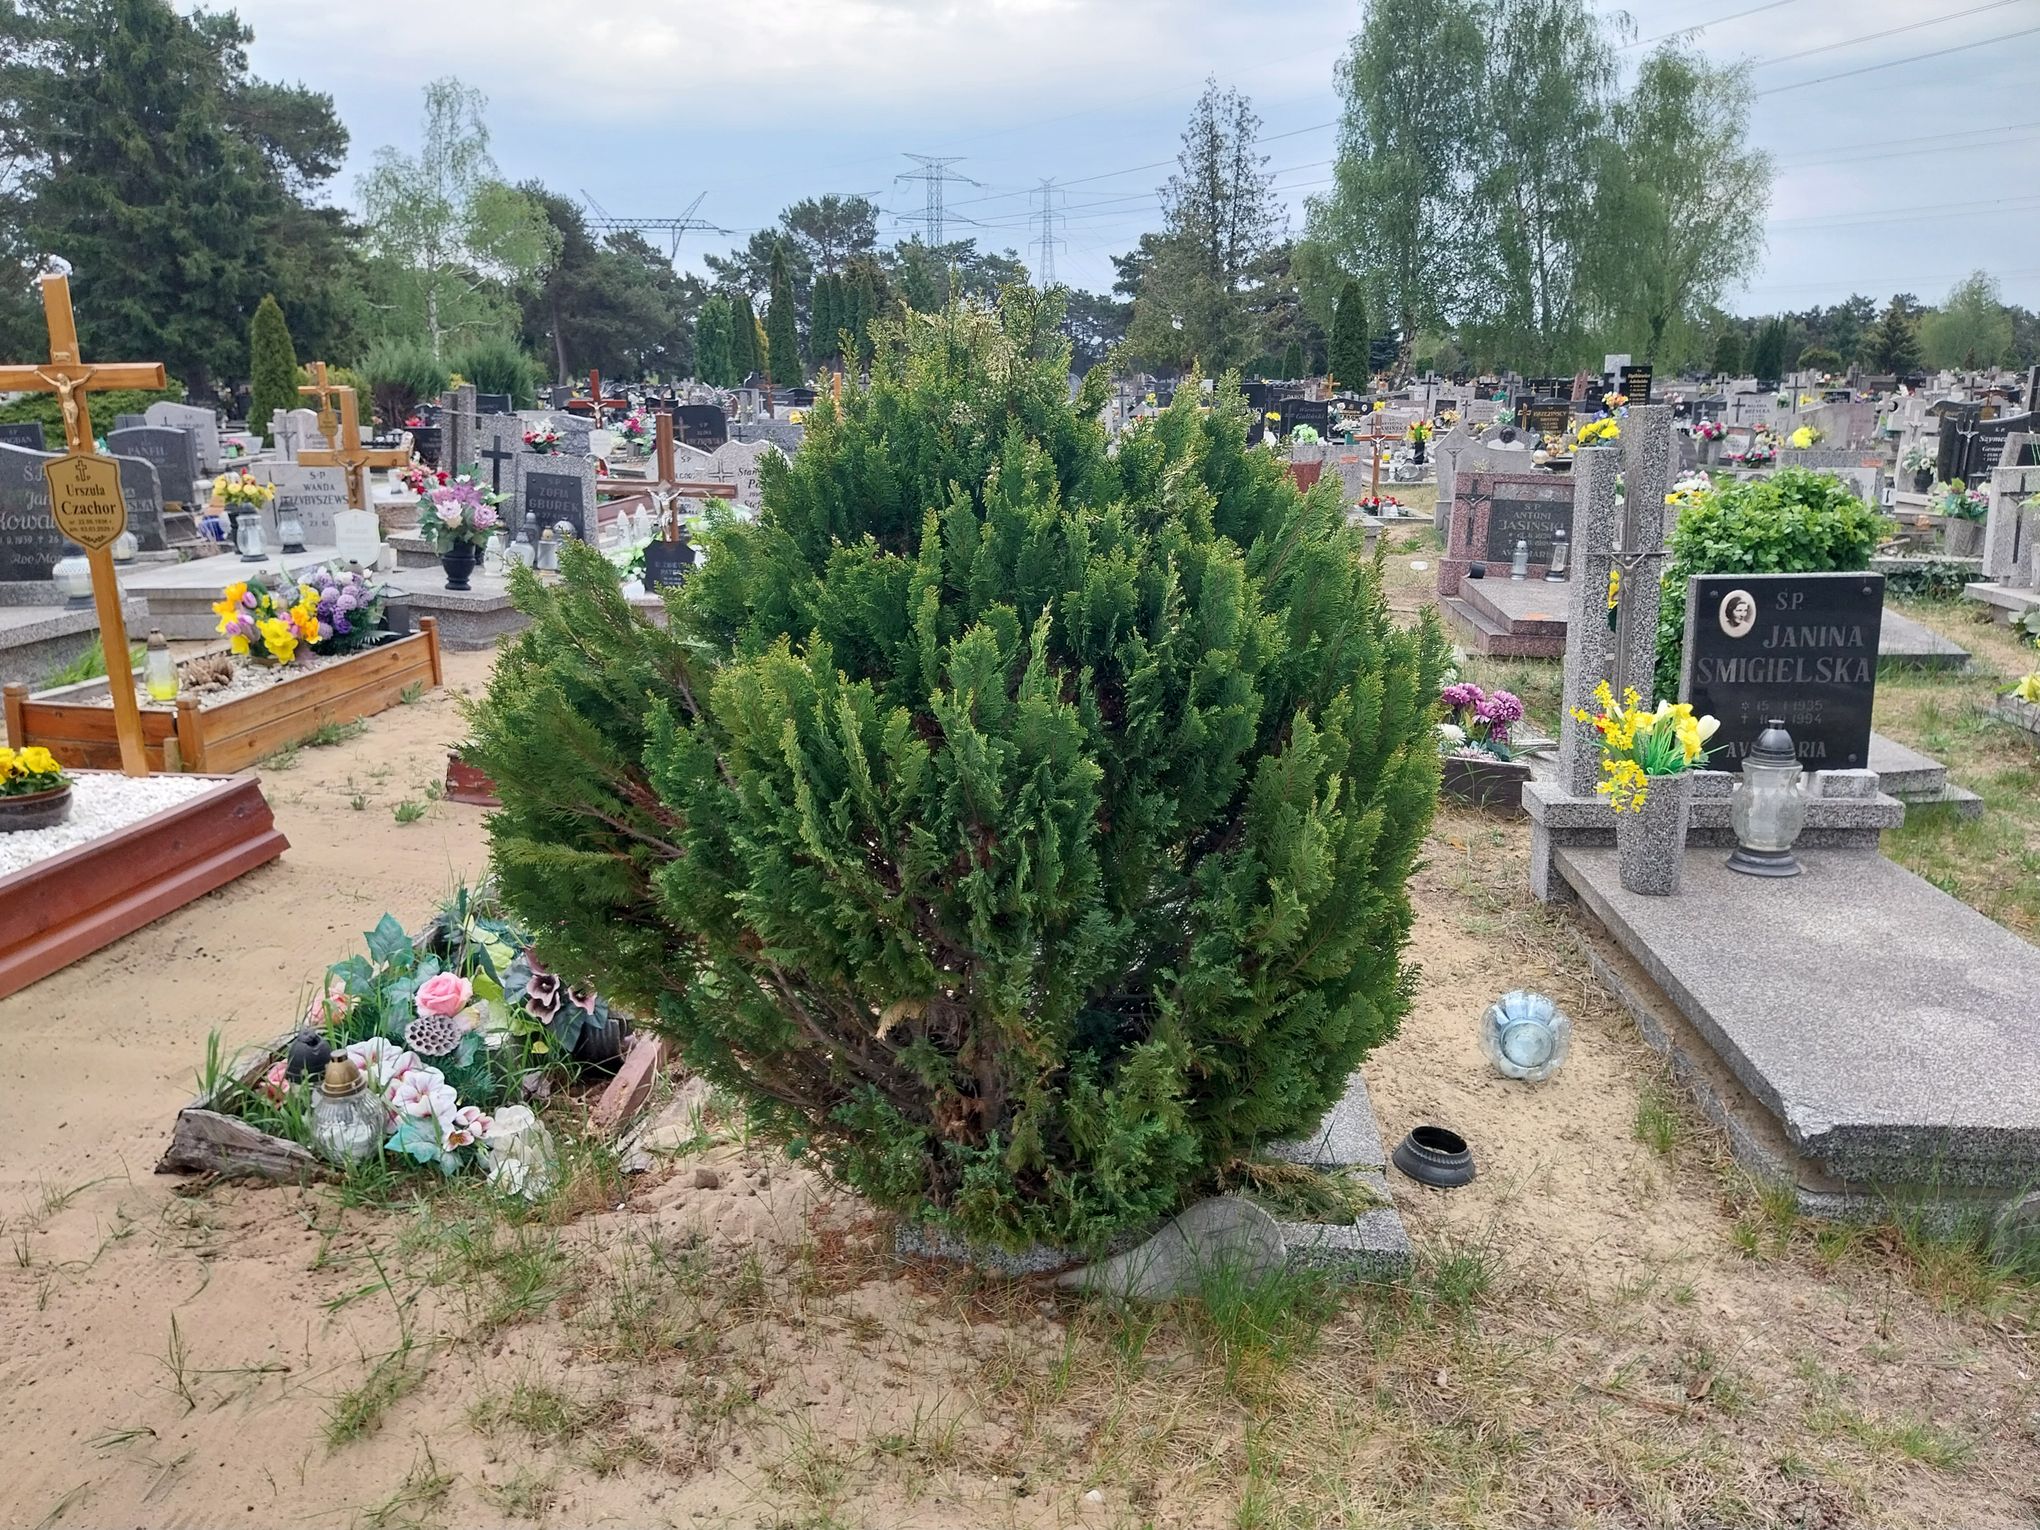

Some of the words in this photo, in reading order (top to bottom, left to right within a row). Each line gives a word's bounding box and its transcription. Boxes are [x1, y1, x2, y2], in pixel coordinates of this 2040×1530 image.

[65, 484, 106, 497] Urszula
[303, 483, 336, 492] WANDA
[539, 487, 569, 499] ZOFIA
[61, 500, 117, 515] Czachor
[528, 498, 580, 513] GBUREK
[1512, 511, 1552, 520] ANTONI
[1762, 624, 1865, 649] JANINA
[1756, 701, 1769, 711] 15
[1793, 700, 1824, 711] 1935
[1792, 712, 1823, 725] 1994
[1725, 741, 1751, 759] AV
[1798, 741, 1827, 759] RIA
